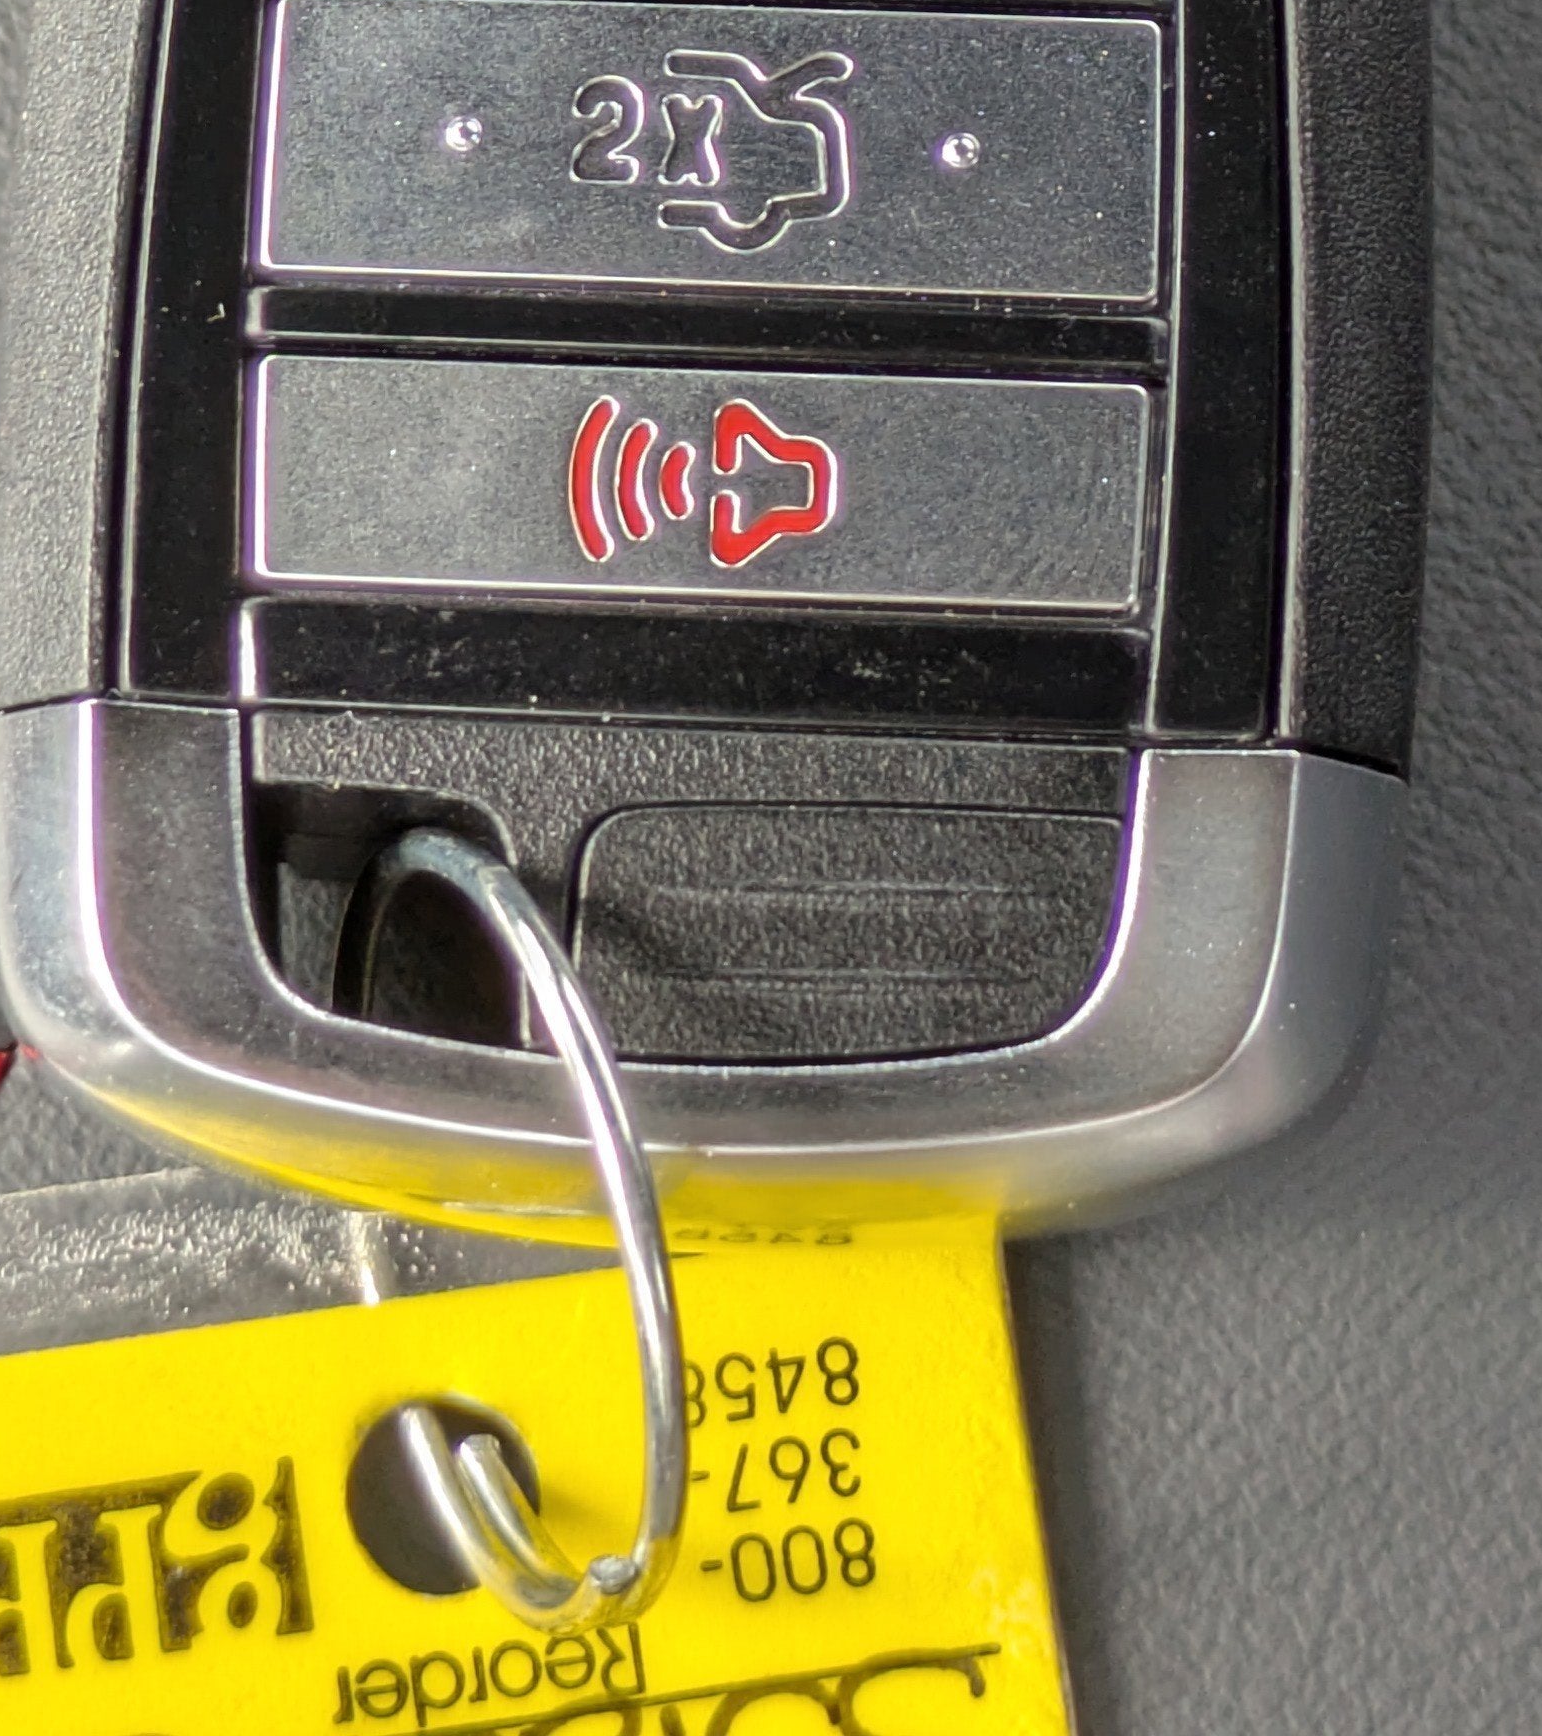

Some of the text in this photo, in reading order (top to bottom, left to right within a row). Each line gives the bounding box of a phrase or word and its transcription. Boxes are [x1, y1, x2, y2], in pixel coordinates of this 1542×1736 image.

[690, 1428, 861, 1513] 367-
[701, 1517, 876, 1602] 800-
[332, 1623, 646, 1726] Reorder
